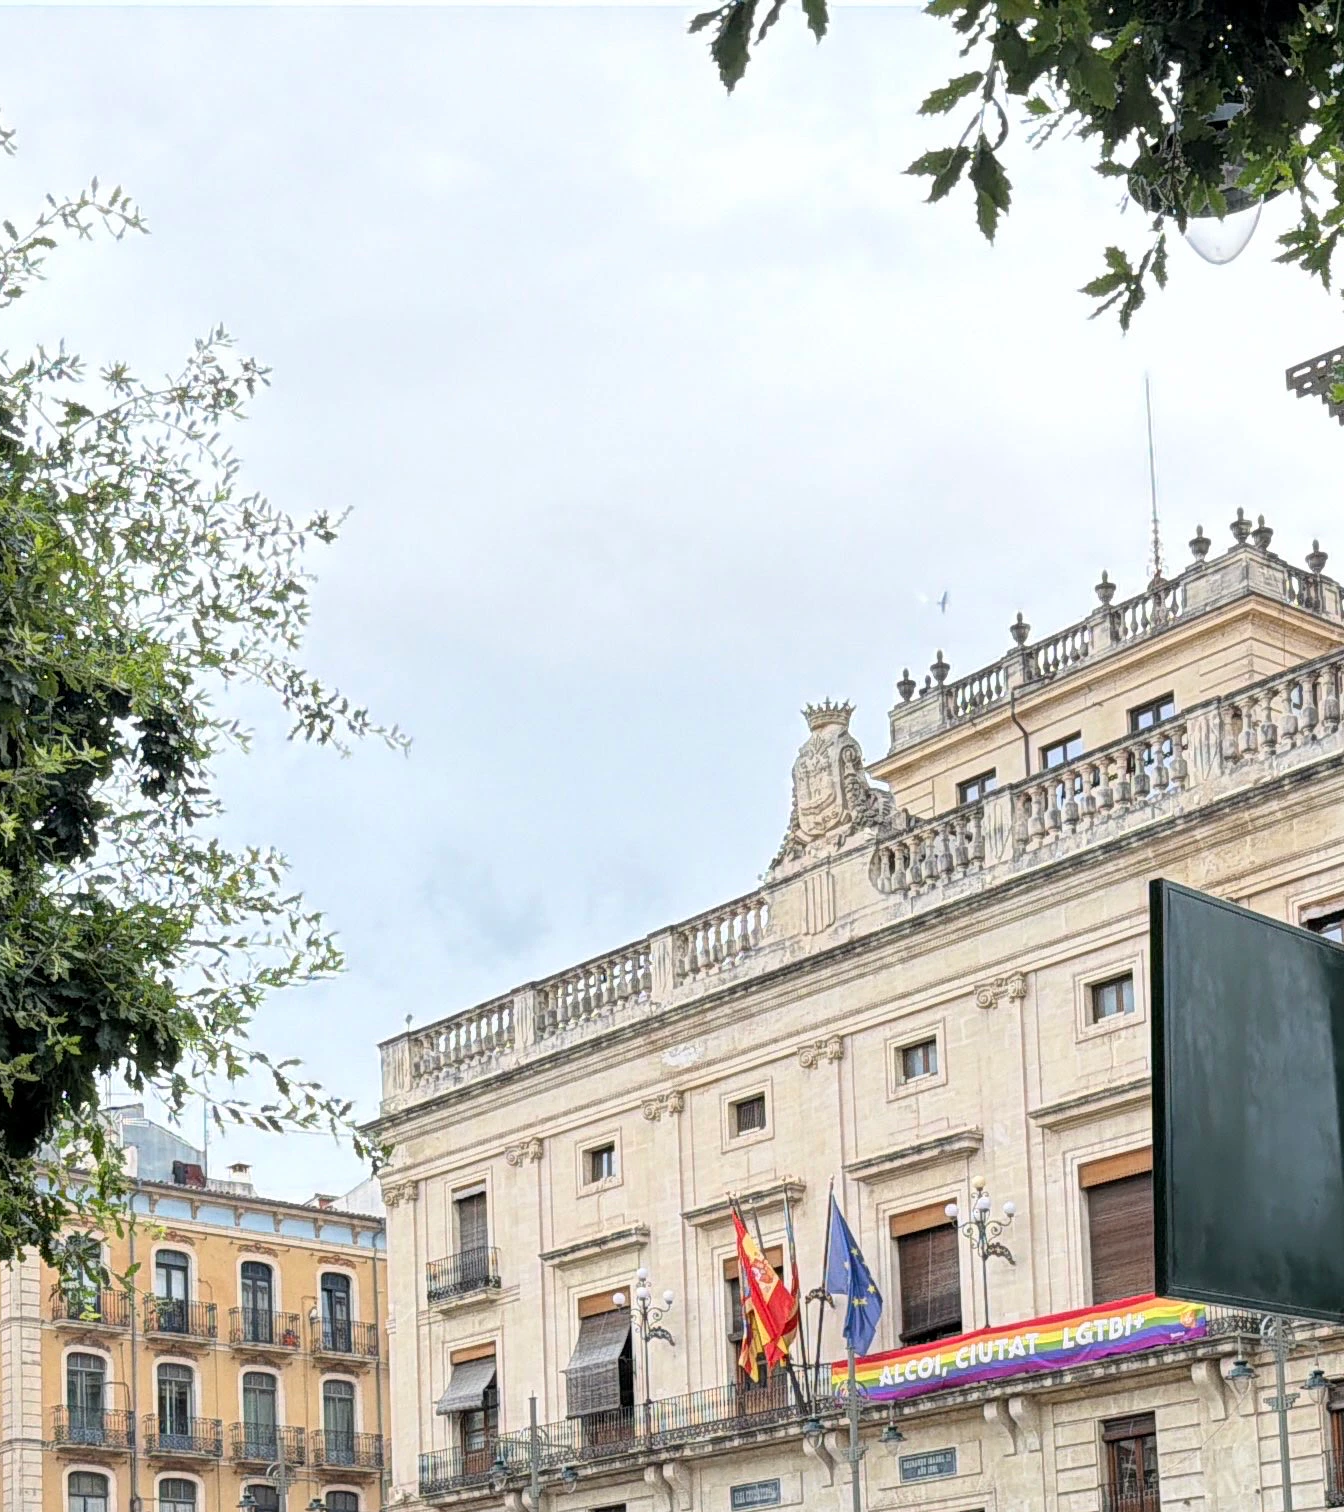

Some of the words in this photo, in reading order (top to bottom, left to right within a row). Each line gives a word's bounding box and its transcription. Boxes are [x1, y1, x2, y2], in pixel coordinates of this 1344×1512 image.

[879, 1355, 948, 1387] ALCOI,
[955, 1333, 1040, 1369] CIUTAT
[1062, 1312, 1145, 1350] LGTBI+
